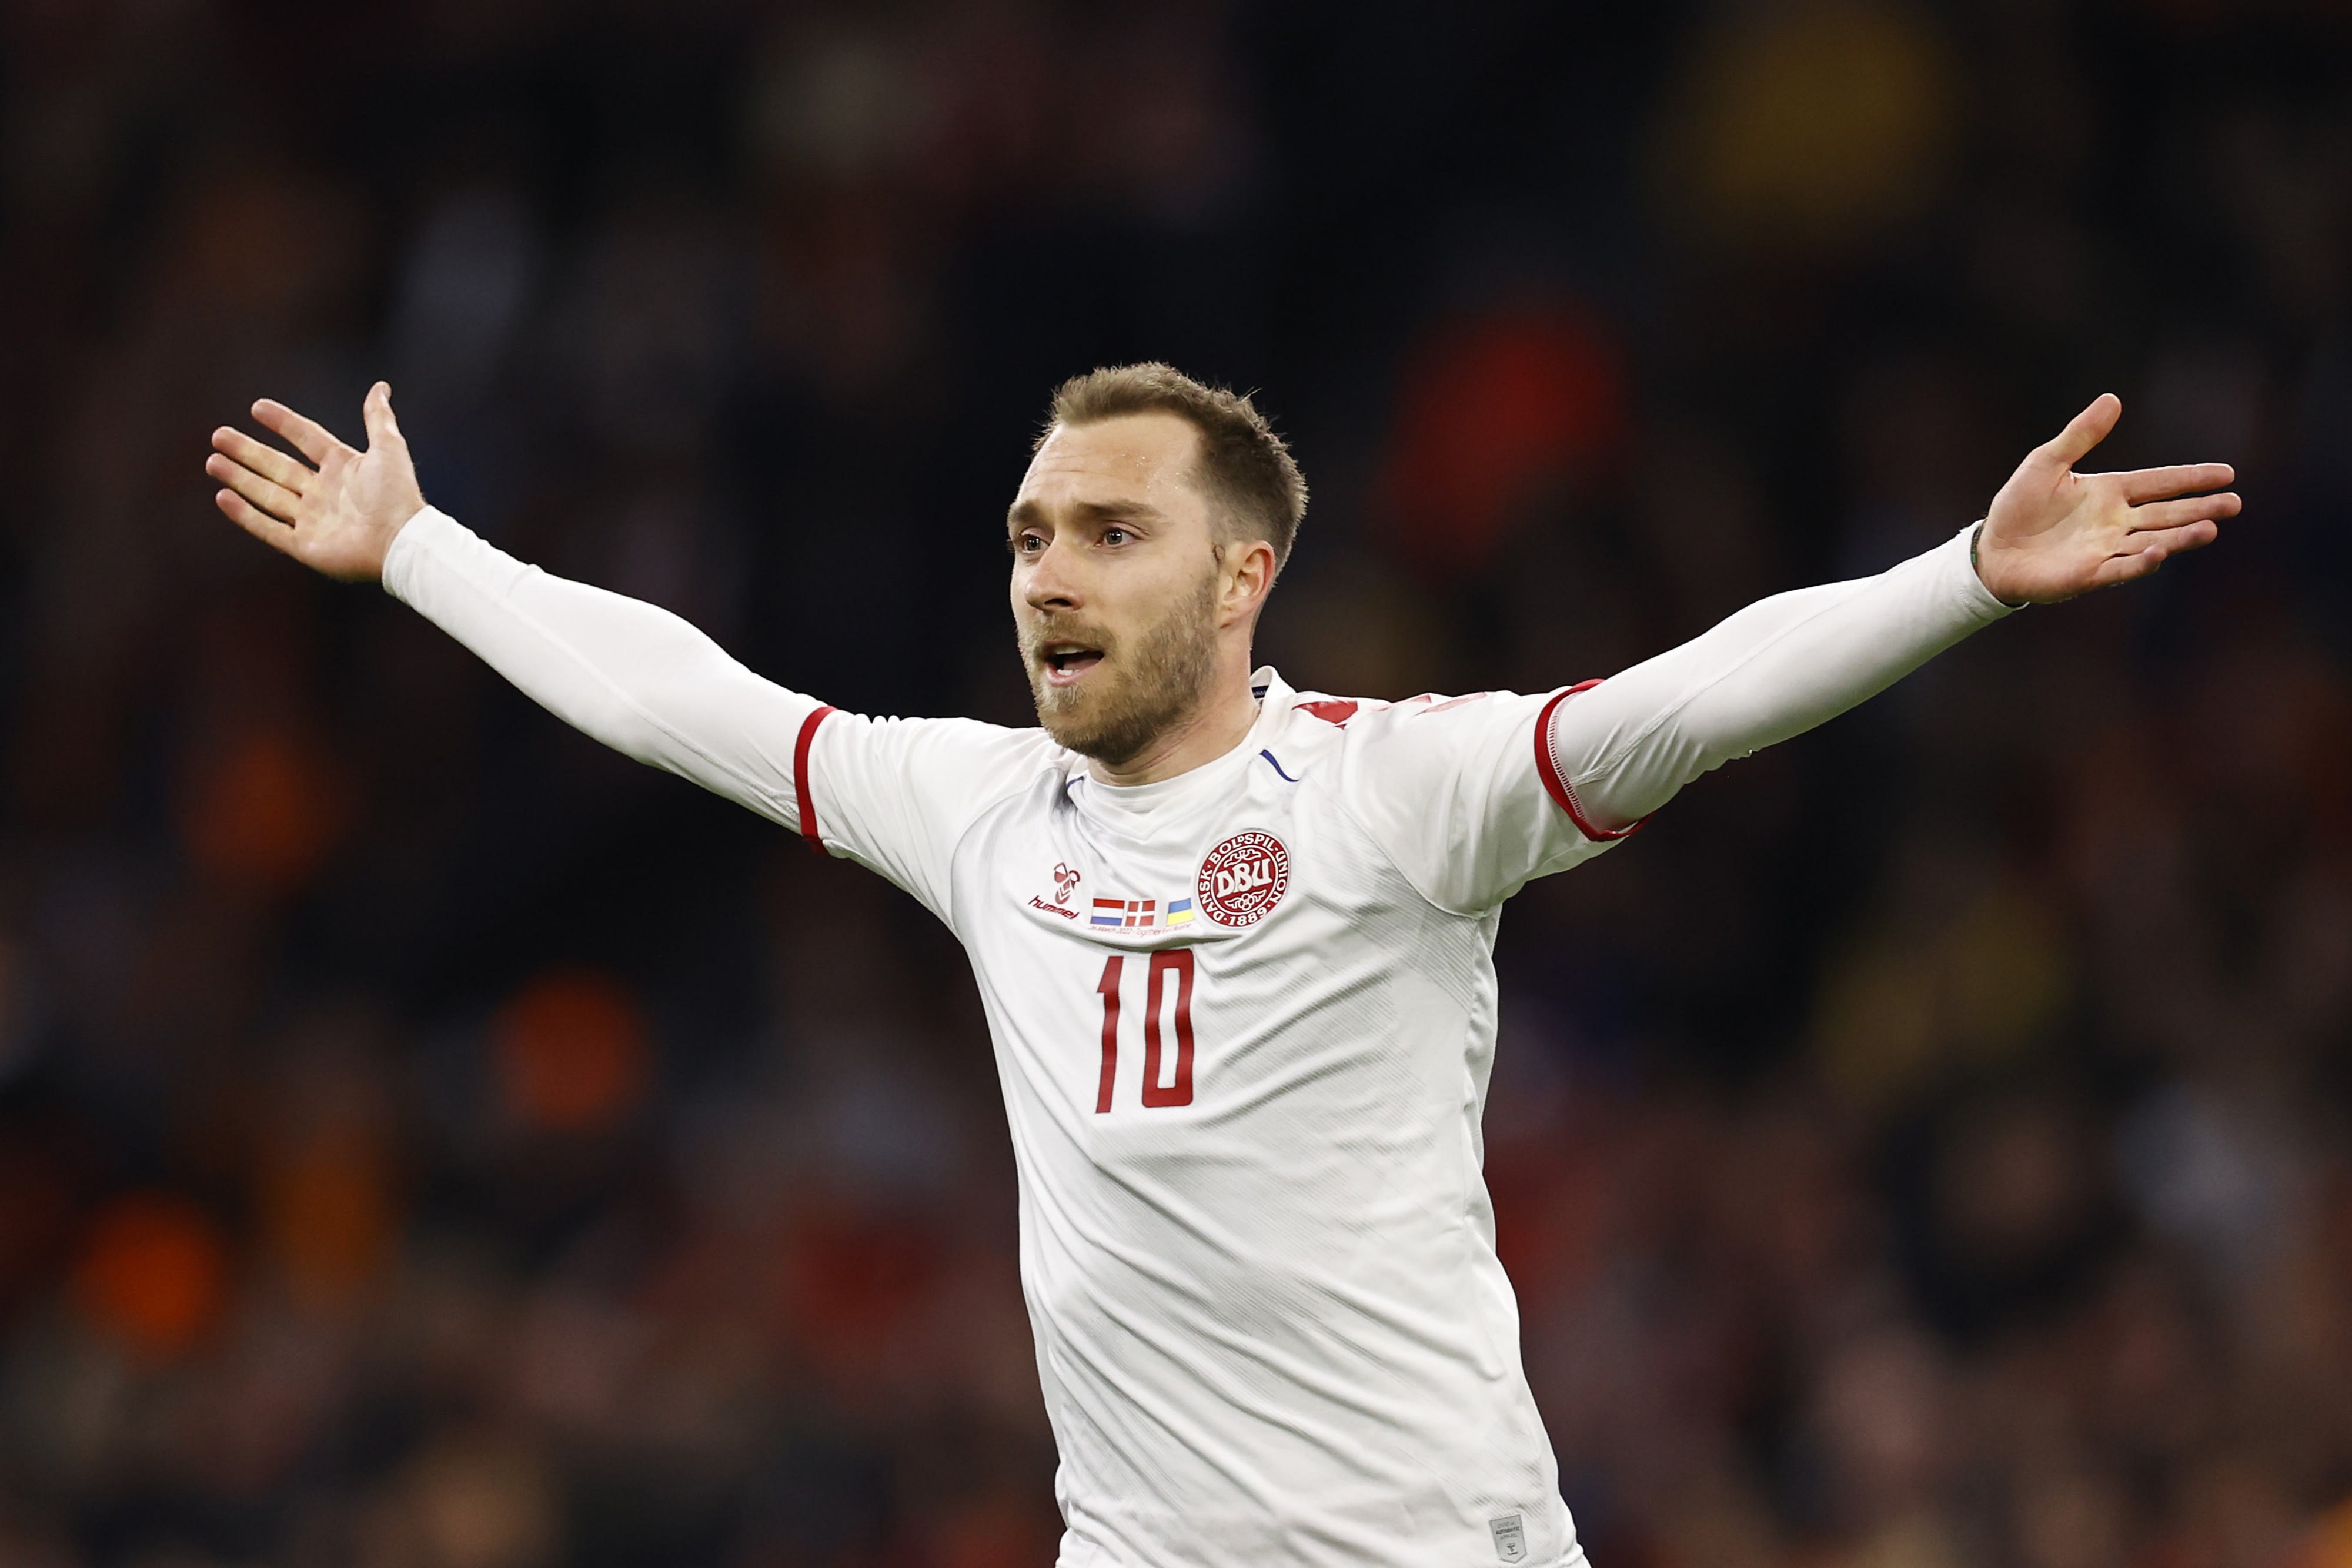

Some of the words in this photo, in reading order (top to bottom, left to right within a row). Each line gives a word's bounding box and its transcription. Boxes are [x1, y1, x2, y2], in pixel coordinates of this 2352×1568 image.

[1199, 869, 1225, 921] DANSK
[1228, 907, 1267, 926] 1889
[1215, 858, 1273, 898] DBU
[1028, 895, 1080, 920] hummel
[1095, 948, 1194, 1114] 10
